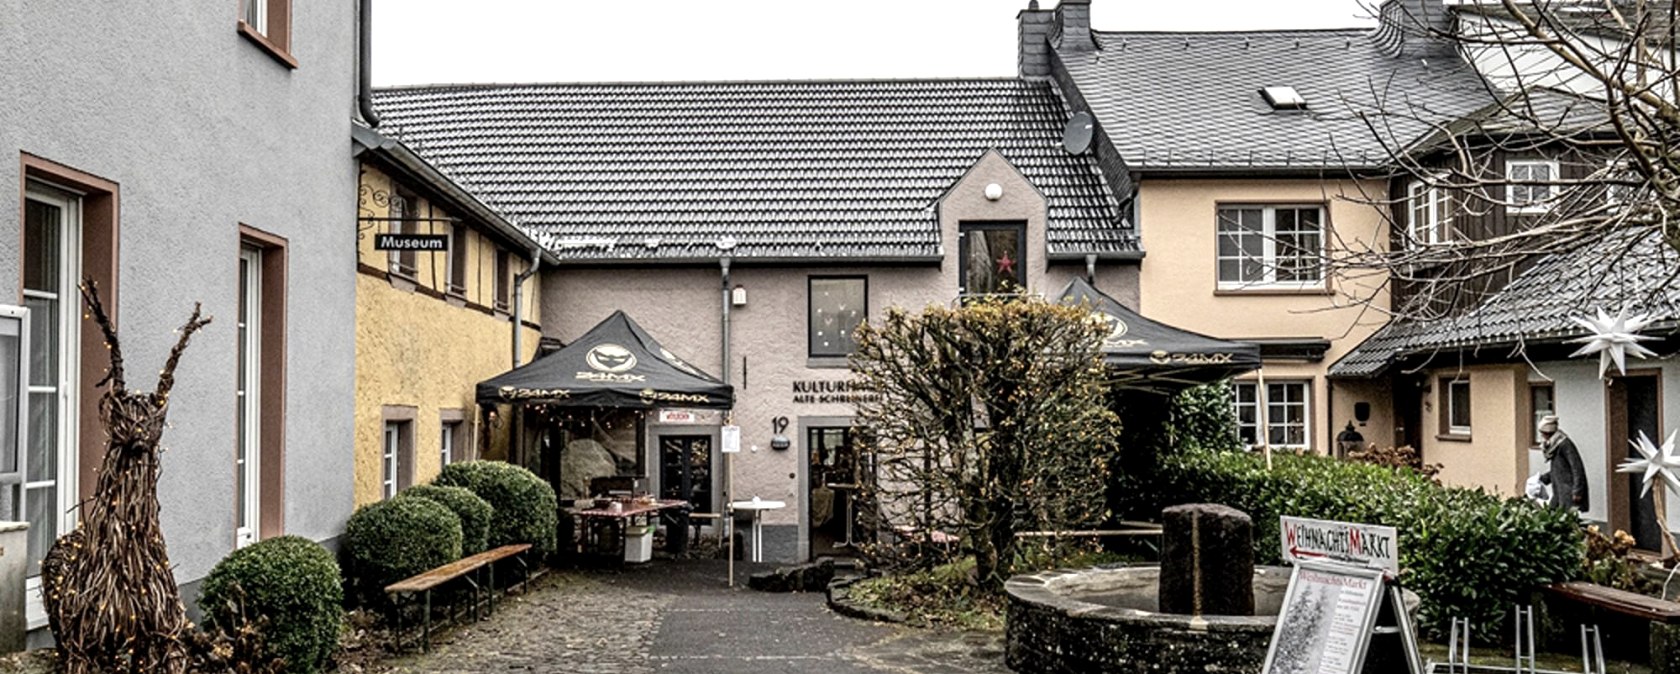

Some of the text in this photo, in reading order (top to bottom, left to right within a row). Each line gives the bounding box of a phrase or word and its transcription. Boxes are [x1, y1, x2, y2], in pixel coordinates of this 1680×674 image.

[381, 236, 443, 249] Museum
[575, 371, 646, 383] 24MX
[657, 391, 711, 404] 24MX
[792, 394, 815, 404] ALTE
[771, 415, 790, 434] 19
